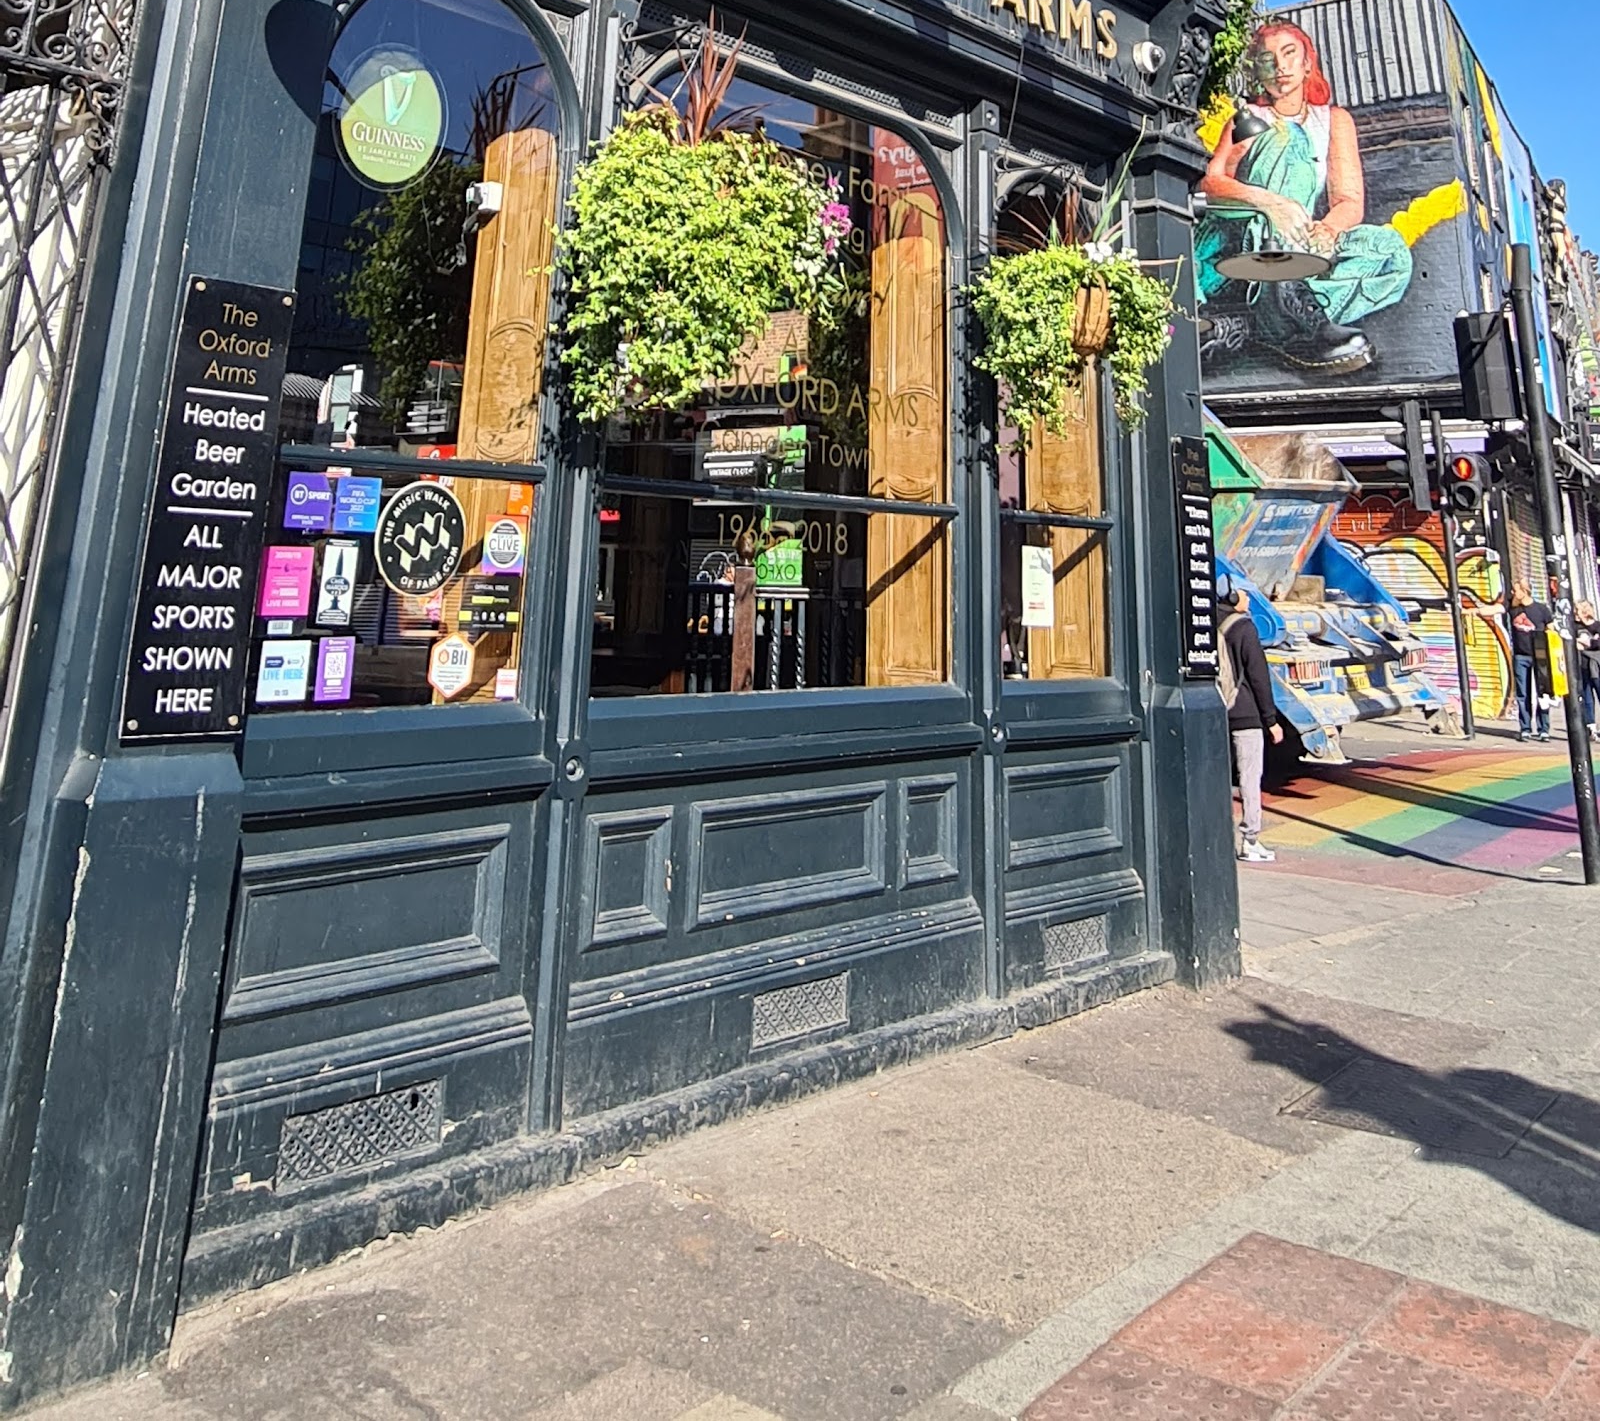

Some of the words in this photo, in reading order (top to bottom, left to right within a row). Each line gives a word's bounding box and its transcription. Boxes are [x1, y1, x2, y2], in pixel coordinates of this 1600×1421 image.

[351, 121, 426, 153] GUINNESS
[222, 303, 258, 328] The
[198, 329, 270, 358] Oxford
[203, 361, 257, 385] Arms
[182, 401, 266, 432] Heated
[847, 383, 919, 427] ARMS
[194, 439, 246, 465] Beer
[818, 434, 875, 470] Town
[170, 472, 257, 501] Garden
[308, 490, 331, 500] SPORT
[384, 519, 396, 544] THE
[393, 491, 422, 519] MUSIC
[424, 490, 451, 511] WALK
[183, 524, 223, 549] ALL
[489, 538, 520, 552] CLIVE
[157, 564, 243, 591] MAJOR
[400, 575, 414, 588] OF
[152, 604, 235, 630] SPORTS
[142, 645, 233, 672] SHOWN
[154, 687, 214, 714] HERE
